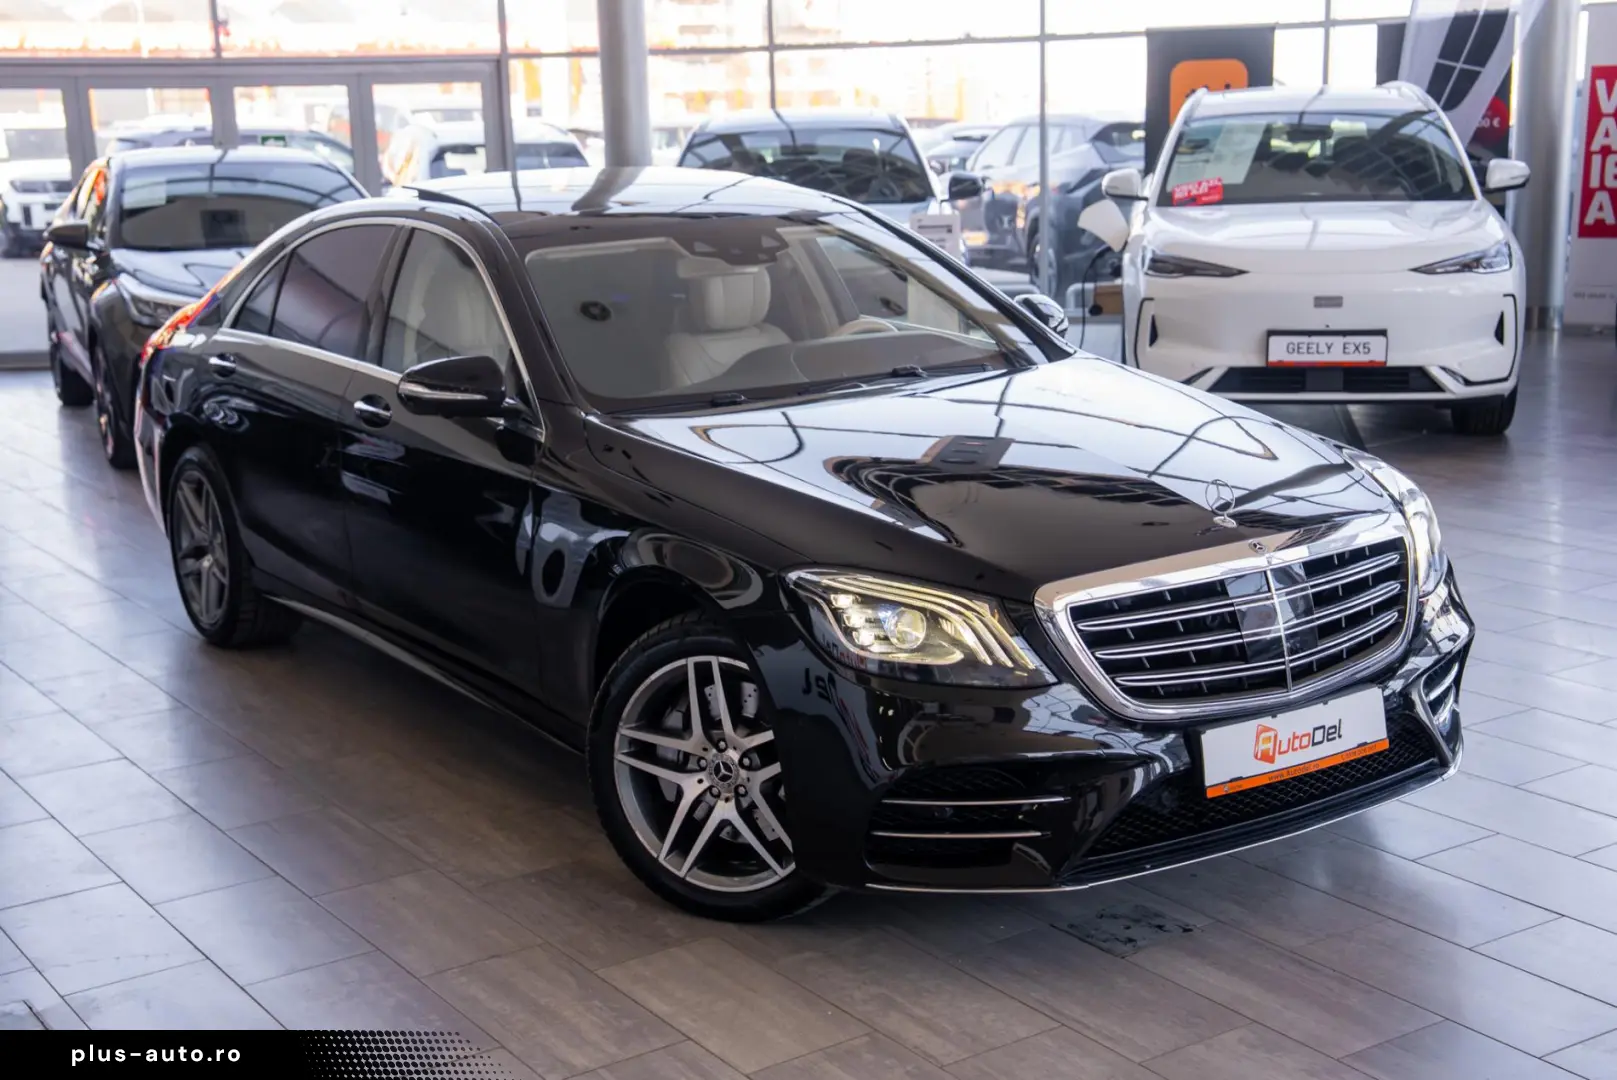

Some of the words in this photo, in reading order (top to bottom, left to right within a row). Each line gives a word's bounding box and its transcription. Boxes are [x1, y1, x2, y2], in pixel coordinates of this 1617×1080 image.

[1286, 342, 1333, 355] GEELY
[1342, 342, 1371, 355] EX5
[1254, 718, 1342, 765] AutoDel
